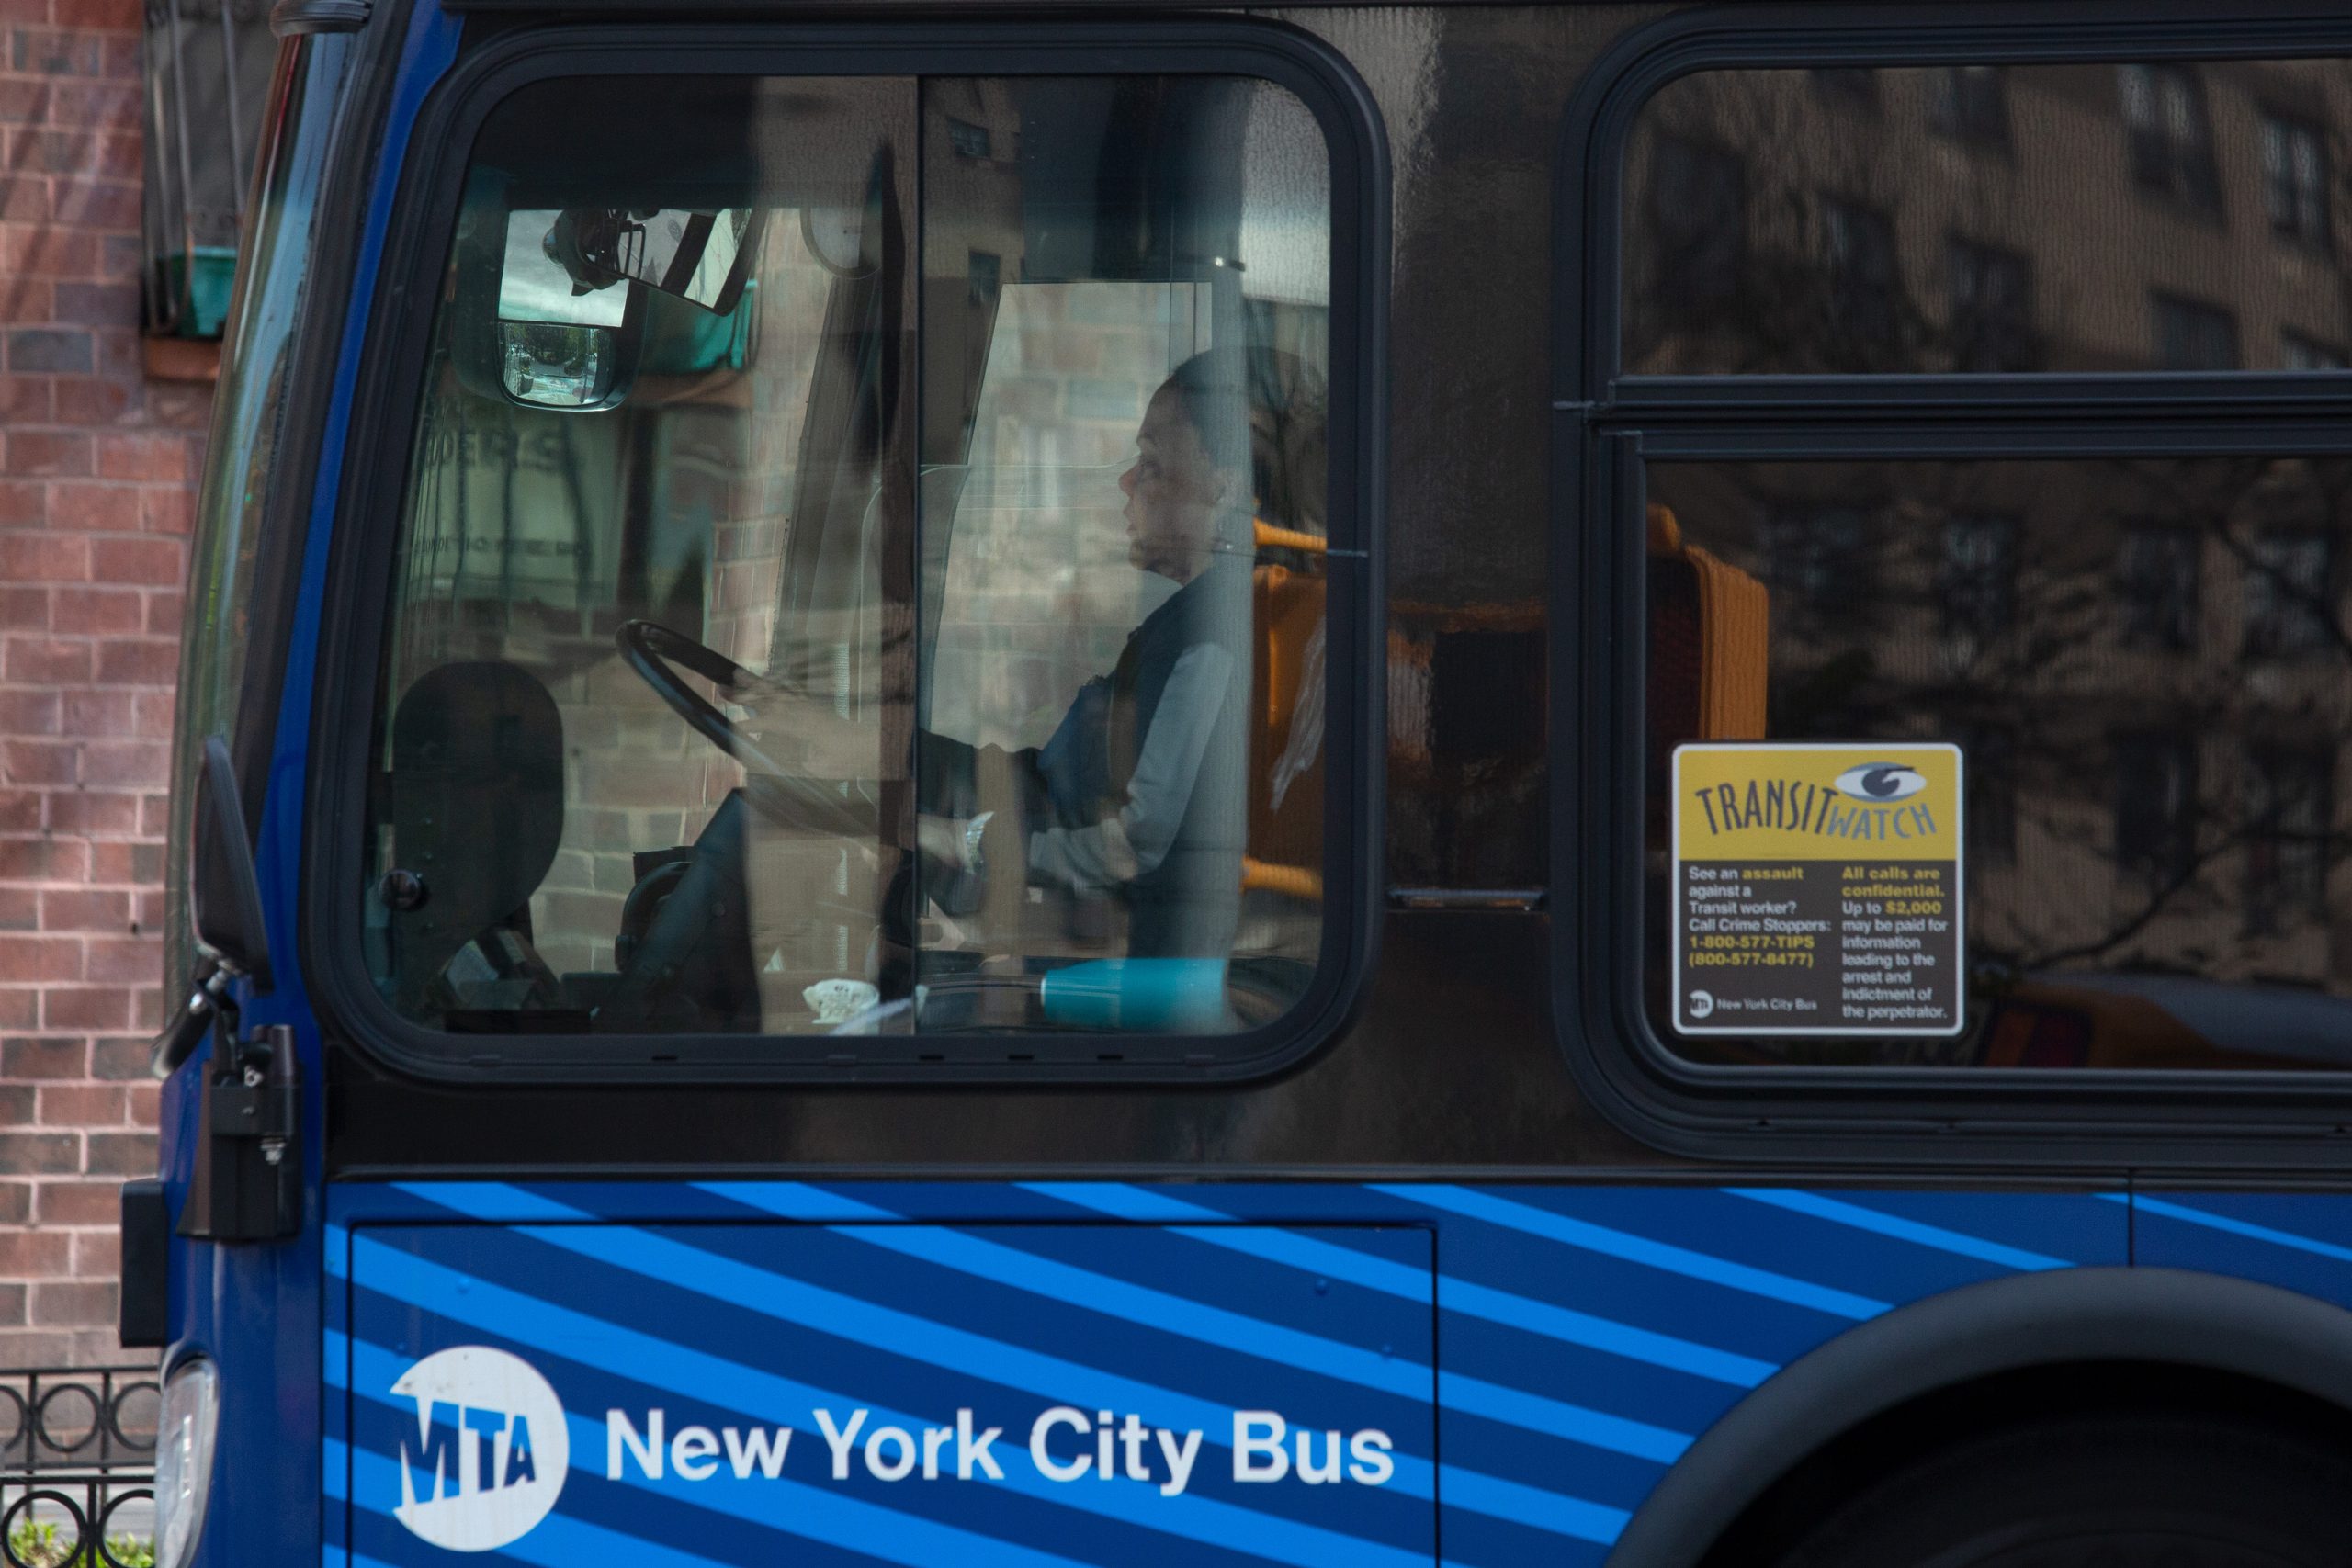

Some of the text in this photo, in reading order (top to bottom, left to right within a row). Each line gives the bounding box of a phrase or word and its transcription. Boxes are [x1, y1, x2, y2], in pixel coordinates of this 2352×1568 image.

[1695, 780, 1937, 840] TRANSIT WATCH
[1689, 866, 1804, 880] See an assault
[1842, 866, 1940, 880] All calls are
[1689, 884, 1752, 900] against a
[1841, 885, 1945, 897] confidential.
[1689, 900, 1797, 914] Transit worker?
[1842, 900, 1942, 917] Up to $2,000
[1689, 918, 1831, 934] Call Crime Stoppers:
[1842, 919, 1948, 934] may be paid for
[1690, 935, 1815, 949] 1-800-577-TIPS
[1842, 936, 1921, 949] information
[1689, 952, 1814, 968] (800-577-8477)
[1842, 953, 1935, 970] leading to the
[1842, 971, 1912, 984] arrest and
[1842, 987, 1933, 1001] indictment of
[1716, 998, 1817, 1011] New York City Bus
[1842, 1005, 1947, 1021] the perpetrator.
[390, 1392, 537, 1506] MTA
[607, 1406, 1394, 1496] New York City Bus
